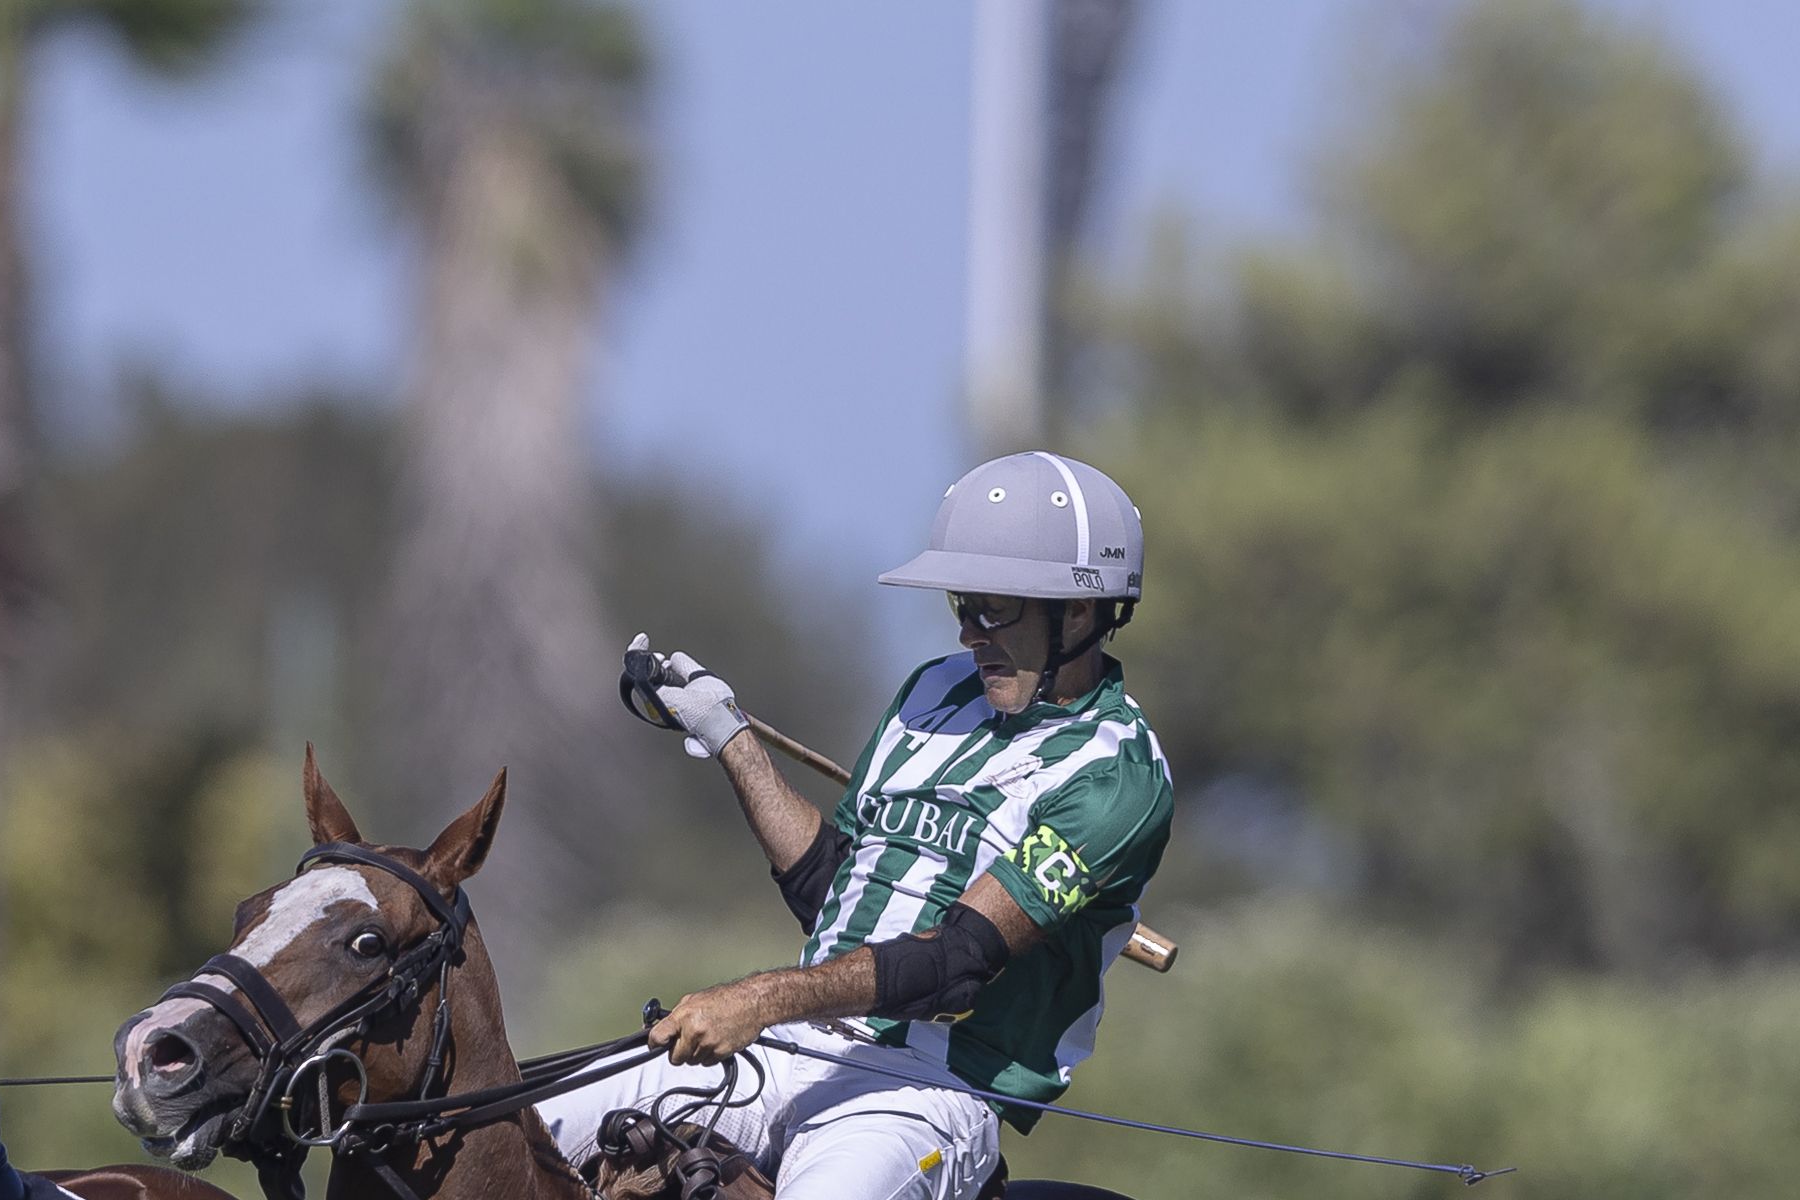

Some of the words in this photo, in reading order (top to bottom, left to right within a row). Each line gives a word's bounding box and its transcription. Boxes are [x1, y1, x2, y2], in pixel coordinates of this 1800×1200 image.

[1100, 546, 1125, 560] JMN
[1073, 572, 1105, 592] POLO
[856, 793, 978, 856] DUBAI
[1034, 850, 1077, 891] C
